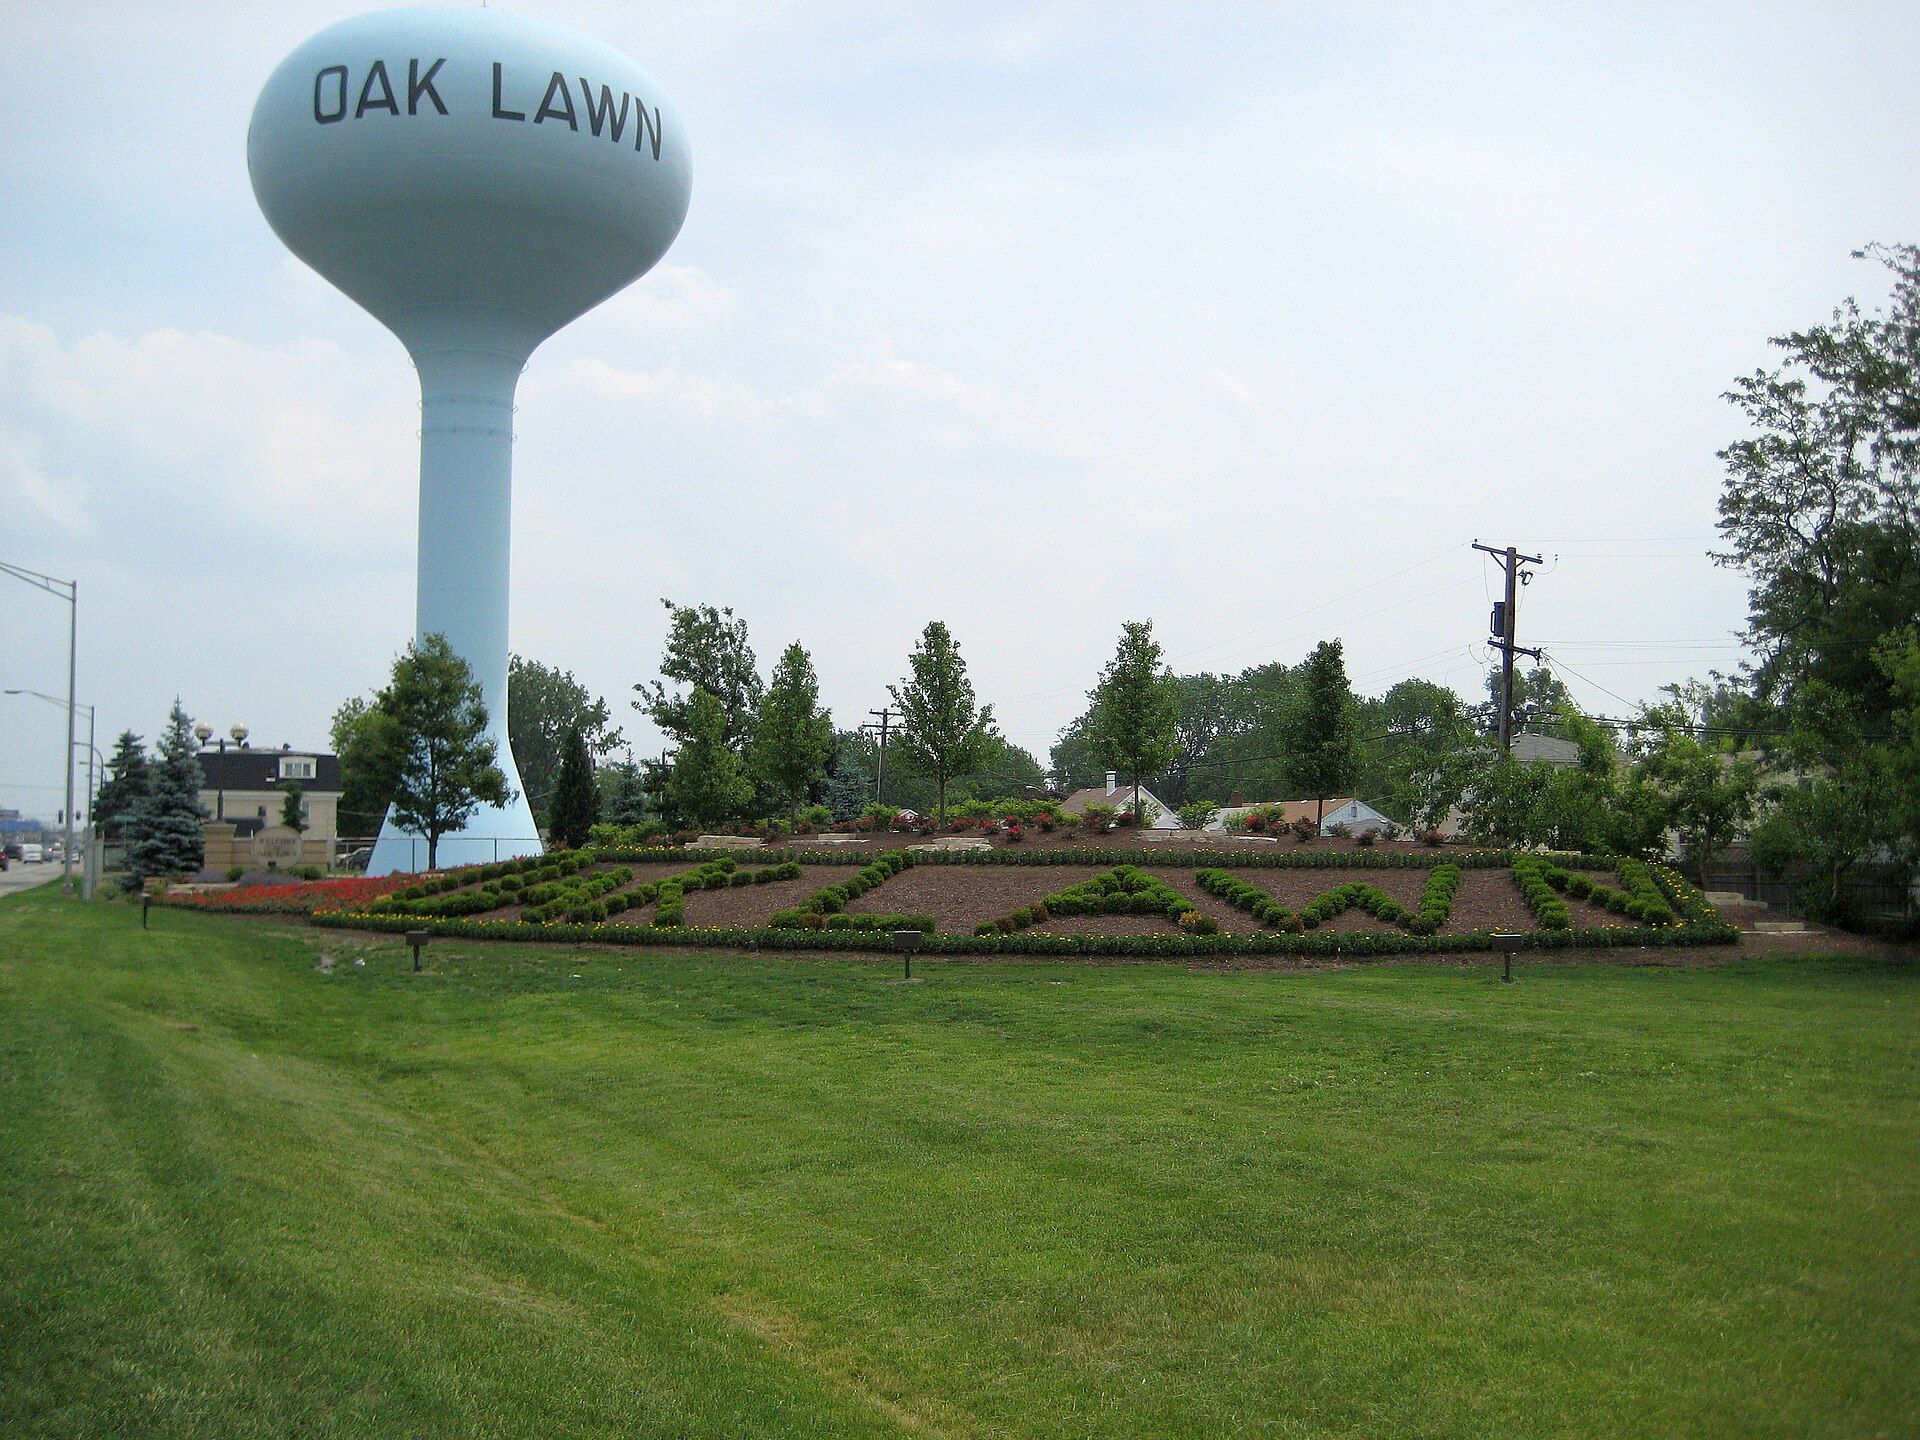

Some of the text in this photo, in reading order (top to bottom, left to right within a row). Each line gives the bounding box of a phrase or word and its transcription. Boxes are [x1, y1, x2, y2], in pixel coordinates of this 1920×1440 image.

[314, 58, 662, 162] OAK LAWN
[768, 850, 1673, 935] LAWN
